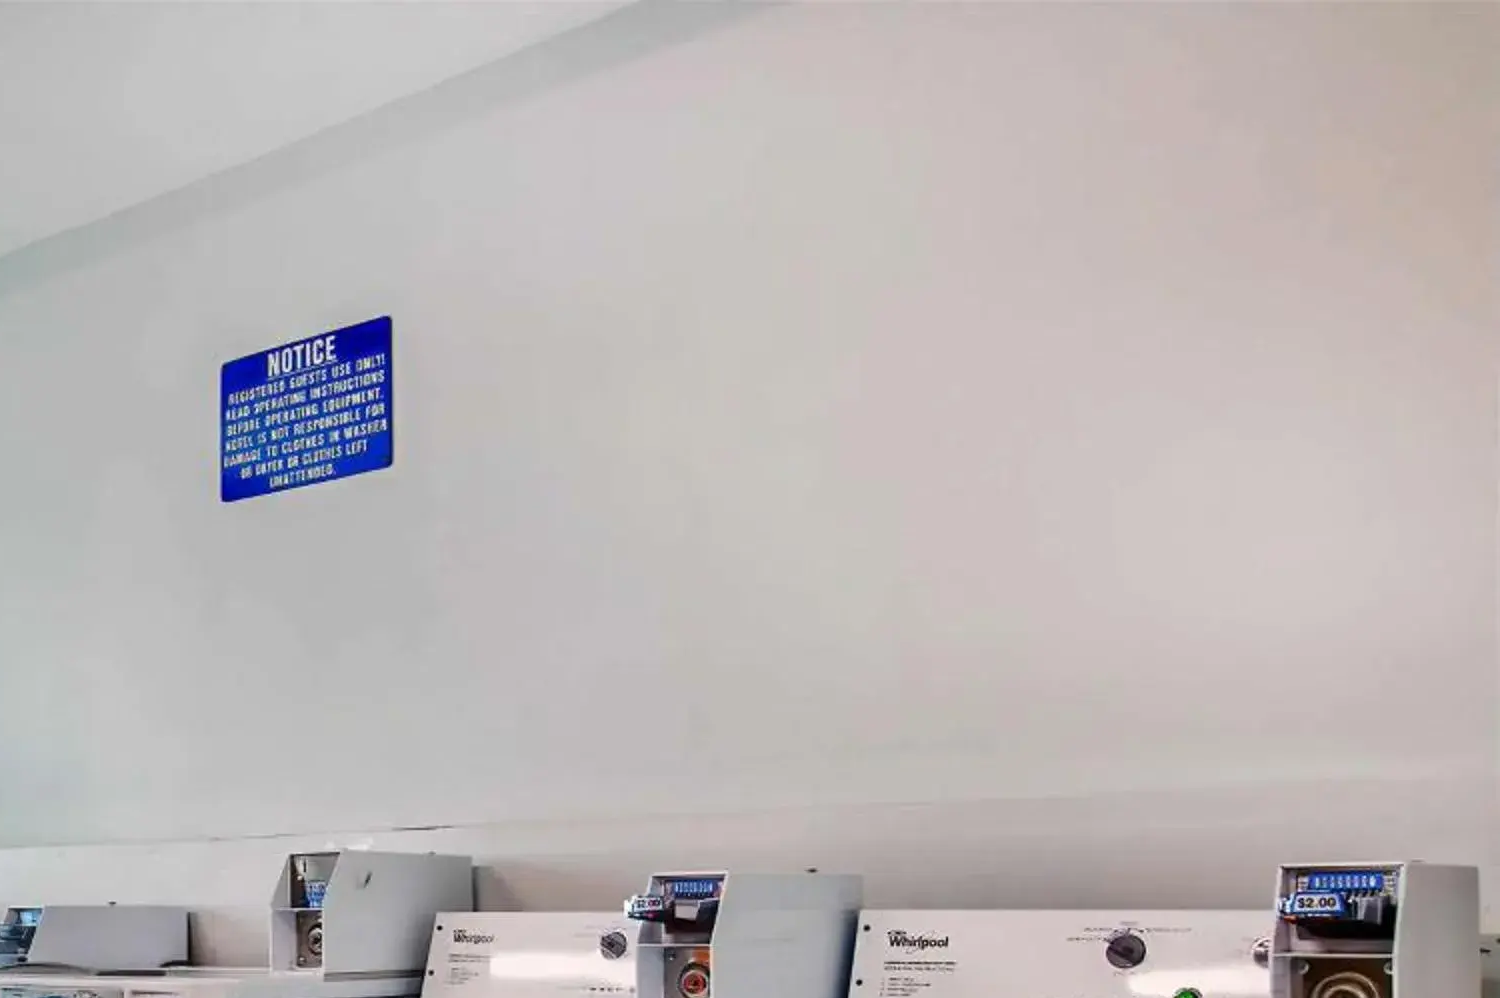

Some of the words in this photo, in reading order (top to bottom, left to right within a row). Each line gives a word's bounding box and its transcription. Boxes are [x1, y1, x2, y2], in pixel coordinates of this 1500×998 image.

[267, 335, 337, 377] NOTICE
[226, 405, 250, 420] READ
[253, 388, 306, 415] OPERATING
[310, 369, 385, 400] INSTRUCTIONS
[228, 382, 285, 405] REGISTERED
[289, 370, 328, 389] GUESTS
[331, 361, 351, 378] USE
[356, 353, 386, 372] ONLY!
[227, 418, 261, 437] BEFORE
[265, 403, 319, 427] OPERATING
[257, 431, 267, 444] IS
[271, 425, 289, 441] NOT
[293, 407, 361, 435] RESPONSIBLE
[365, 402, 385, 419] FOR
[267, 445, 278, 457] TO
[282, 433, 325, 454] CLOTHES
[329, 430, 339, 443] IN
[343, 418, 387, 440] WASHER
[241, 466, 252, 479] OR
[255, 459, 283, 476] DRYER
[288, 455, 299, 468] OR
[302, 444, 342, 465] CLOTHES
[345, 439, 367, 455] LEFT
[1297, 897, 1337, 909] $2.00
[453, 933, 495, 945] Whirlpool
[889, 935, 949, 951] Whirlpool
